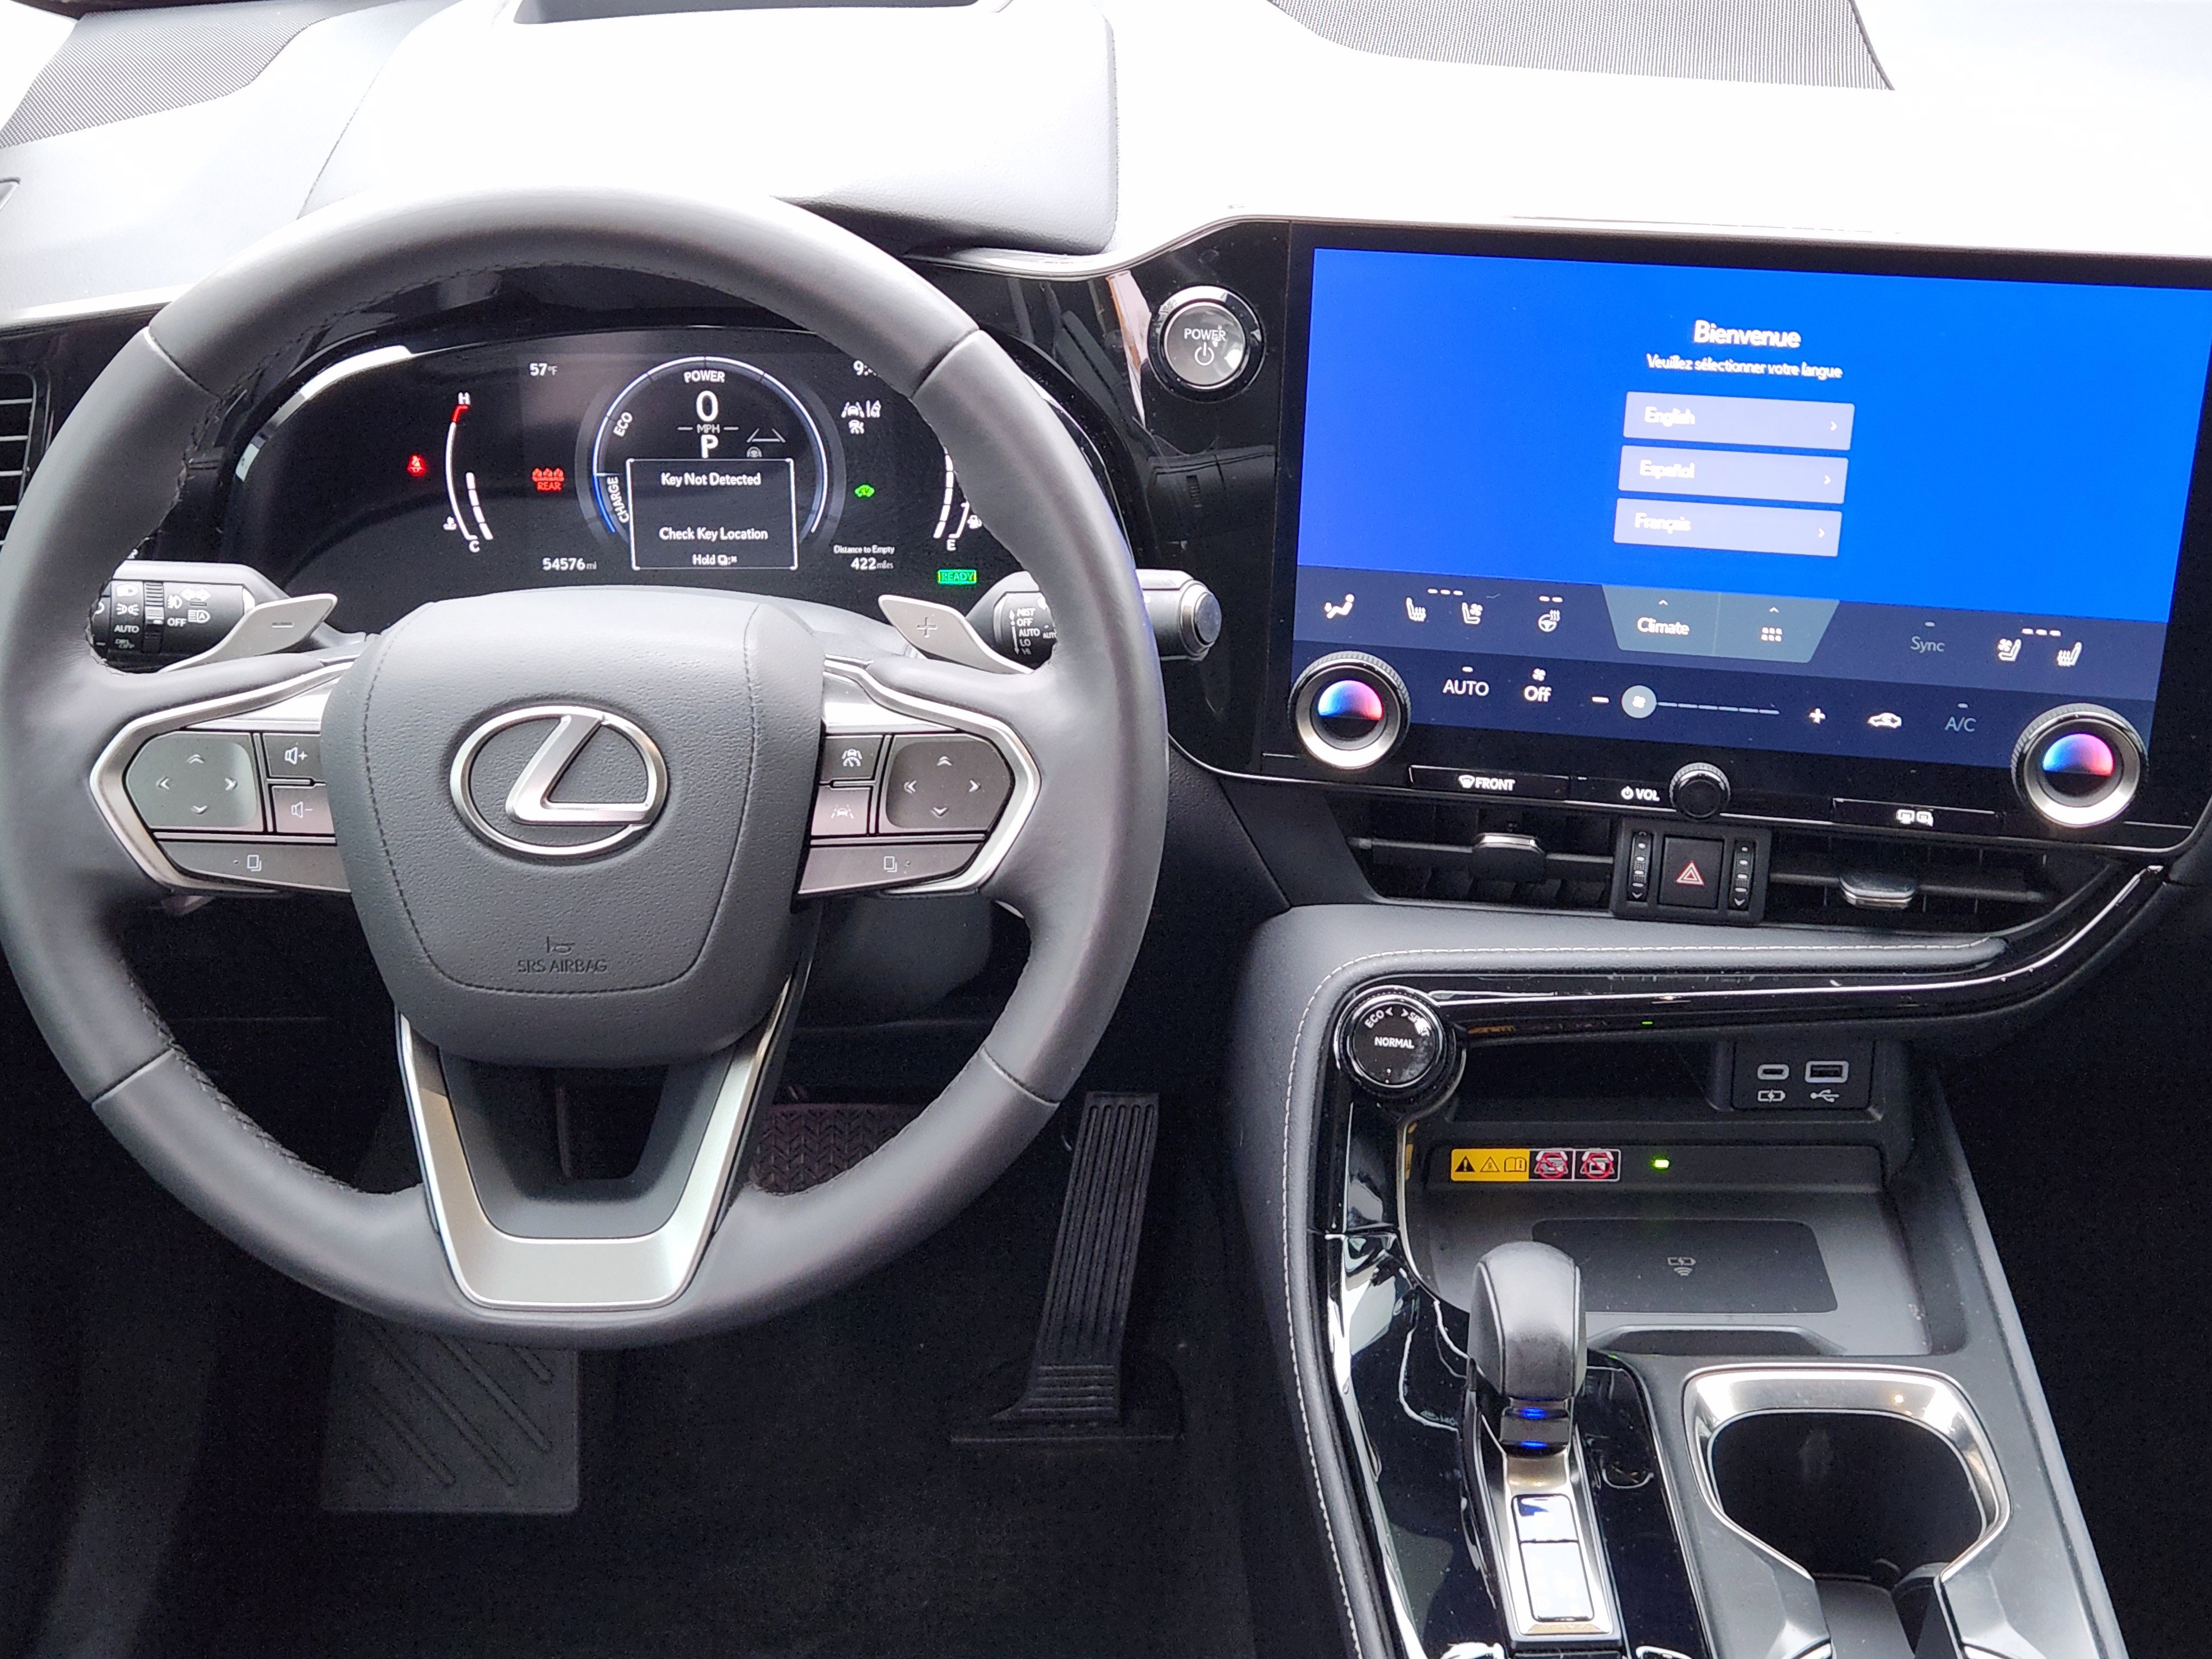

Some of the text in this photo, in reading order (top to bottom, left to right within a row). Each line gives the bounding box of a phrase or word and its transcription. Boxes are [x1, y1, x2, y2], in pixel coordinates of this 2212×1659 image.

[1183, 327, 1226, 341] POWER
[1693, 320, 1802, 348] Bienvenue
[1647, 353, 1843, 380] Veuillez sélectionner votre langue
[684, 369, 726, 383] POWER
[457, 392, 471, 405] H
[613, 411, 633, 437] ECO
[1644, 406, 1695, 427] English
[696, 424, 721, 434] MPH
[700, 434, 719, 458] P
[1639, 460, 1695, 479] Español
[537, 481, 562, 491] REAR
[661, 472, 761, 487] Key Not Detected
[606, 476, 629, 524] CHARGE
[1635, 512, 1691, 534] Français
[659, 526, 769, 542] Check Key Location
[468, 540, 480, 552] C
[833, 545, 895, 555] Distance to Empty
[946, 539, 956, 551] E
[692, 554, 716, 565] Hold
[941, 572, 973, 581] READY
[114, 624, 140, 633] AUTO
[167, 617, 187, 628] OFF
[1016, 618, 1034, 627] OFF
[1637, 617, 1690, 635] Climate
[1019, 628, 1041, 637] AUTO
[1019, 638, 1031, 647] LO
[1910, 636, 1945, 654] Sync
[1443, 679, 1490, 697] AUTO
[1524, 685, 1552, 702] Off
[1944, 716, 1976, 733] A/C
[1475, 774, 1516, 791] FRONT
[1635, 787, 1660, 802] VOL
[517, 959, 608, 973] SRS AIRBAG
[1364, 1010, 1384, 1029] ECO
[1374, 1036, 1415, 1050] NORMAL
